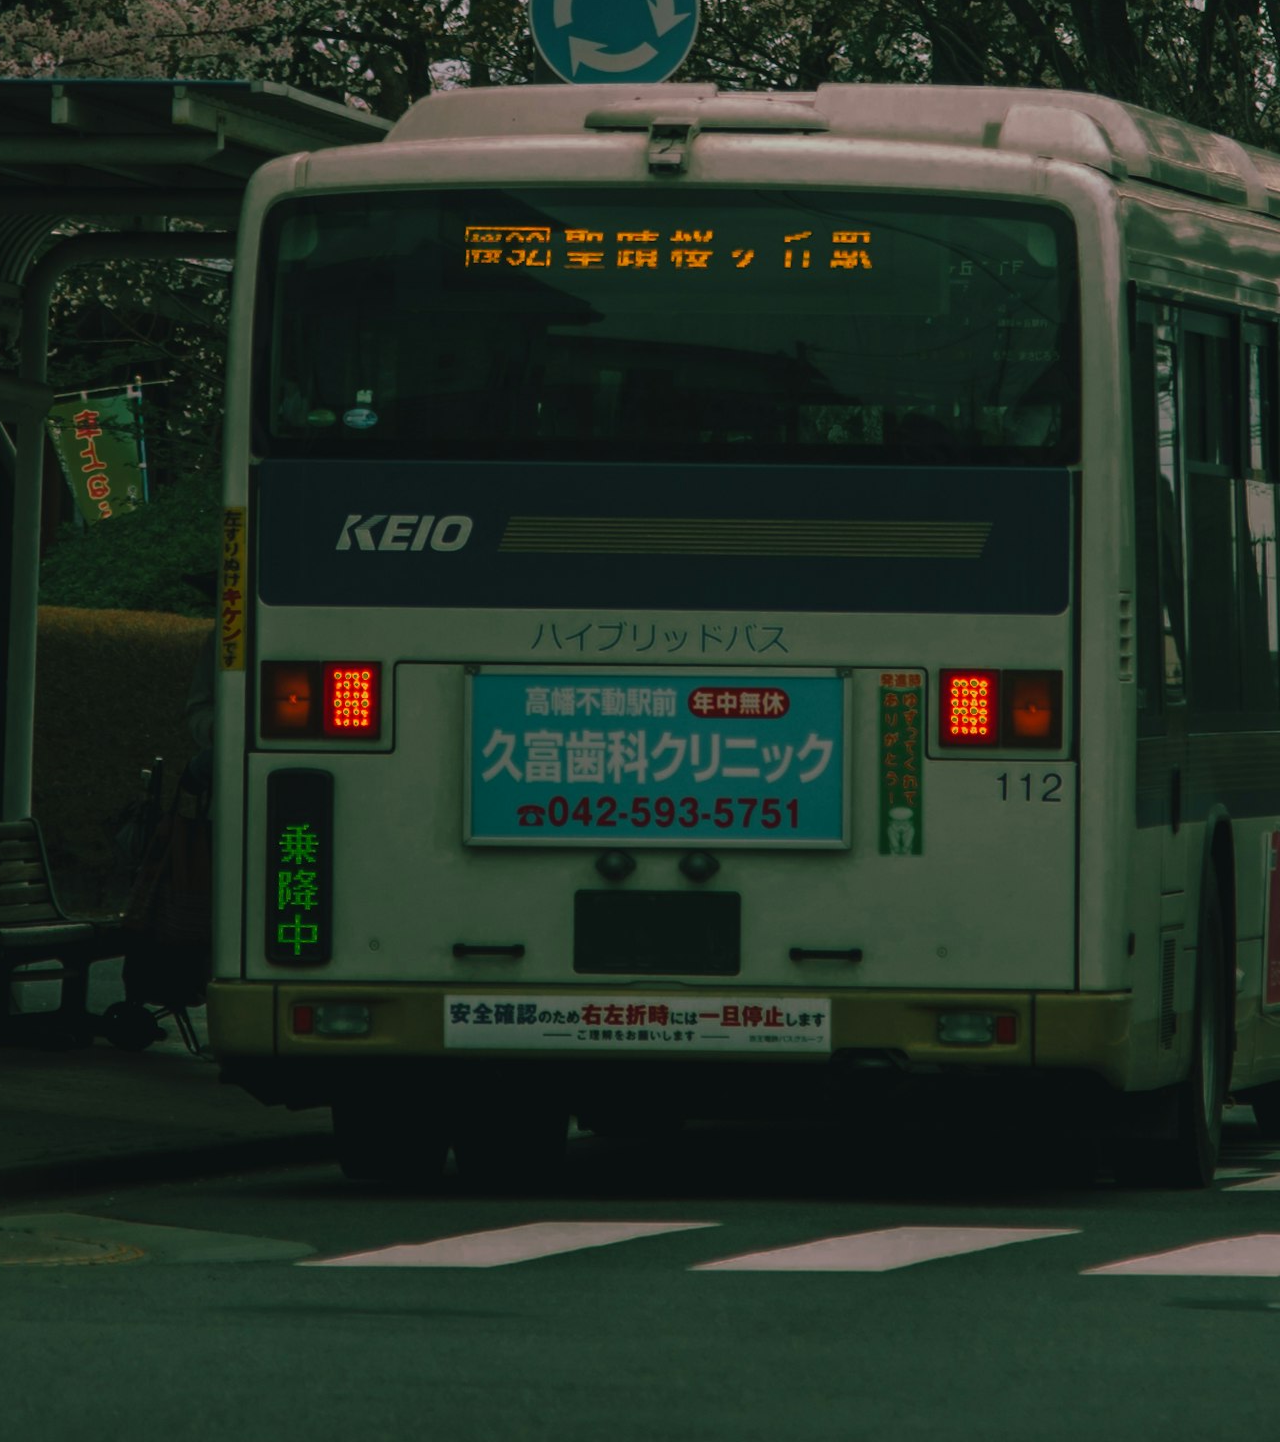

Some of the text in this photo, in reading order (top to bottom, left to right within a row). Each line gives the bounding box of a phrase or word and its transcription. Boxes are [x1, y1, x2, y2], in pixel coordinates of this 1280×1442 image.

[335, 514, 473, 552] KEIO
[531, 622, 788, 653] ハイブリッドバス
[525, 687, 786, 718] 高幡不動駅前 年中無休
[480, 729, 835, 784] 久富歯科クリニック
[996, 773, 1063, 802] 112
[547, 795, 799, 828] 042-593-5751
[278, 823, 320, 955] 乗降中
[449, 1002, 825, 1028] 安全確認のため右左折時には一旦停止します
[577, 1029, 696, 1042] ご理解をお願いします
